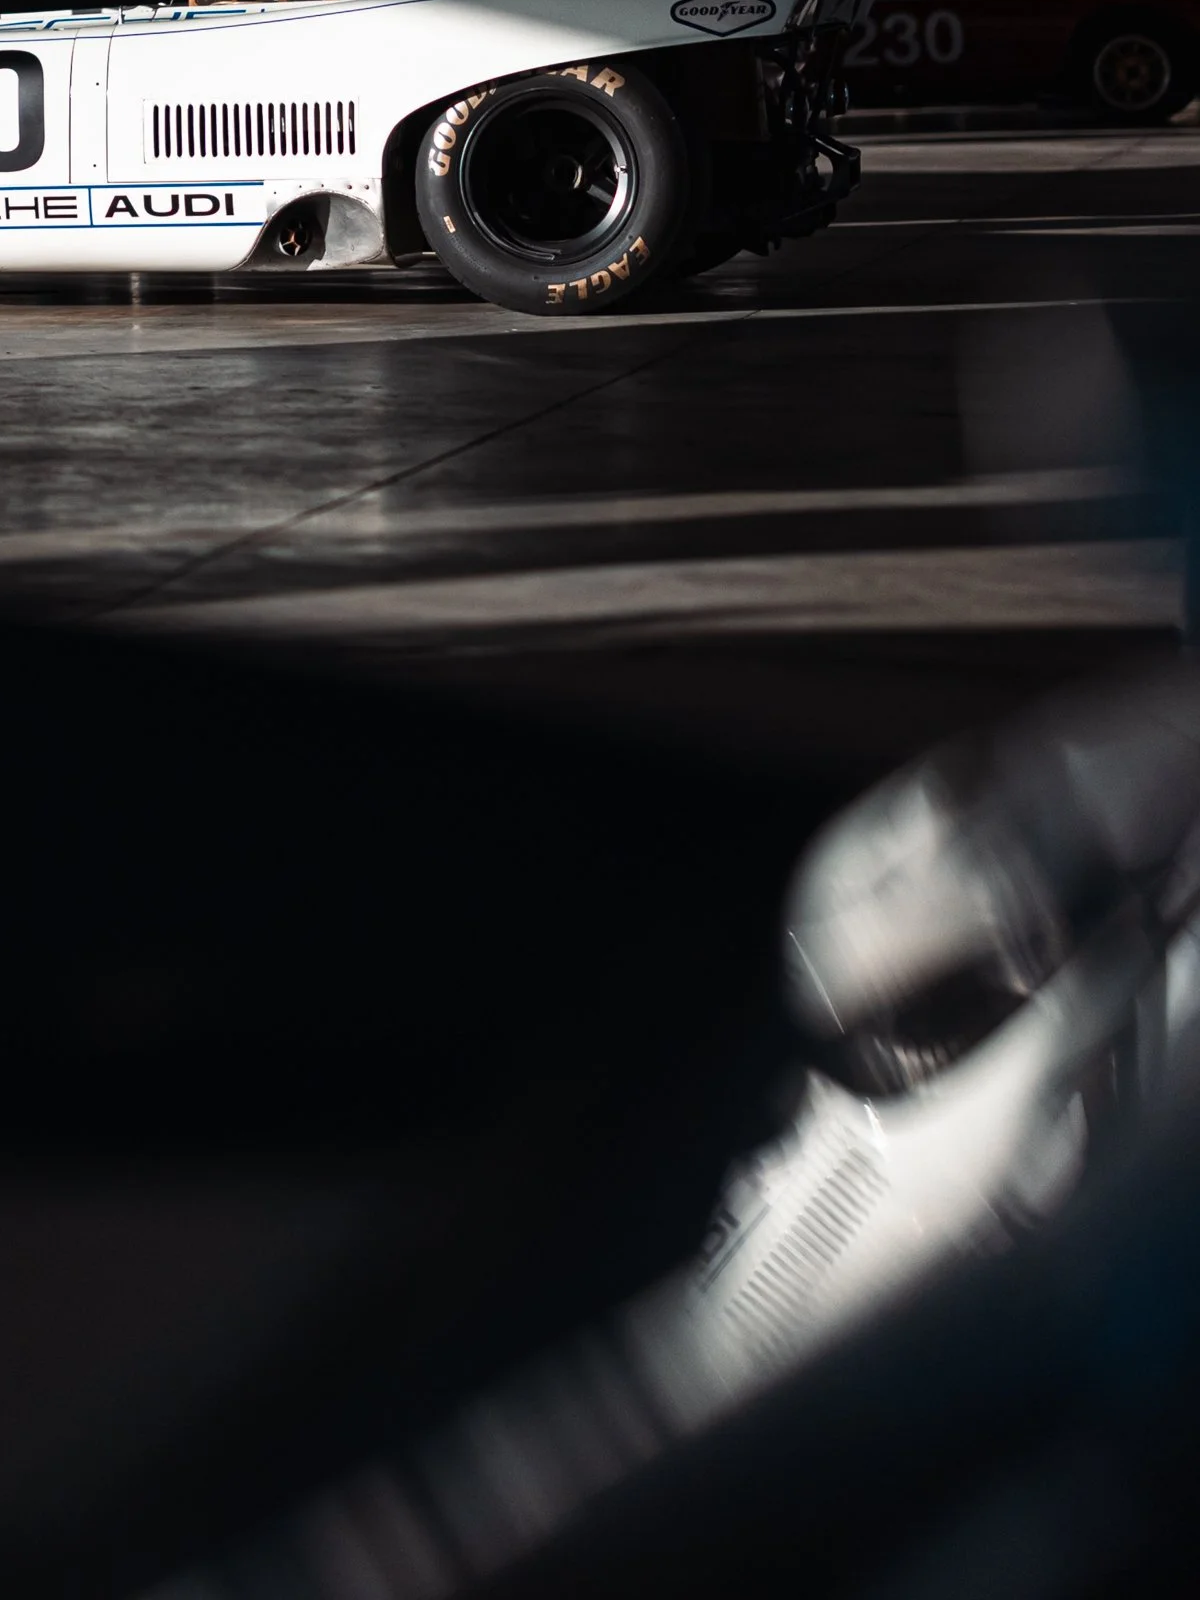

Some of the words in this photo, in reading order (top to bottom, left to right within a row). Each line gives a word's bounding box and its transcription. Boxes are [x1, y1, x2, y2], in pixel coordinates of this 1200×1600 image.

[842, 9, 964, 68] 230
[105, 193, 235, 218] AUDI
[546, 236, 650, 304] EAGLE
